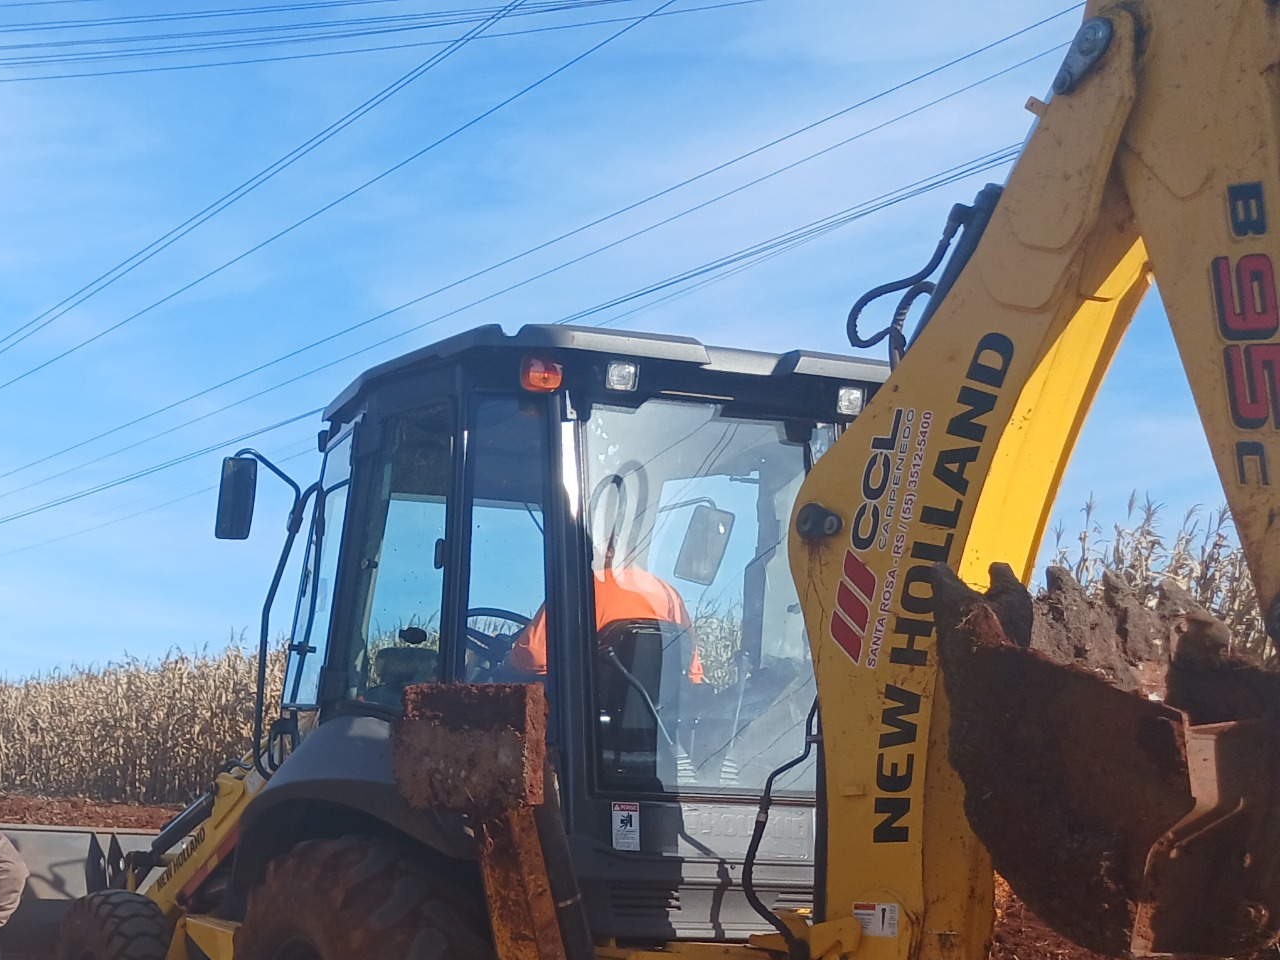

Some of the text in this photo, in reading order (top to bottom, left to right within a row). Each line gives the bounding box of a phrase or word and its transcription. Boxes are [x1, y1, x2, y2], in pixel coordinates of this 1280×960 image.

[850, 408, 903, 551] CCL
[877, 408, 915, 551] CARPENEDO
[907, 411, 933, 490] 3512-5400
[900, 492, 917, 523] (55)
[892, 533, 905, 559] RS
[872, 331, 1016, 844] NEW HOLLAND
[878, 569, 898, 613] ROSA
[867, 616, 886, 668] SANTA
[156, 826, 206, 892] NEW HOLLAND
